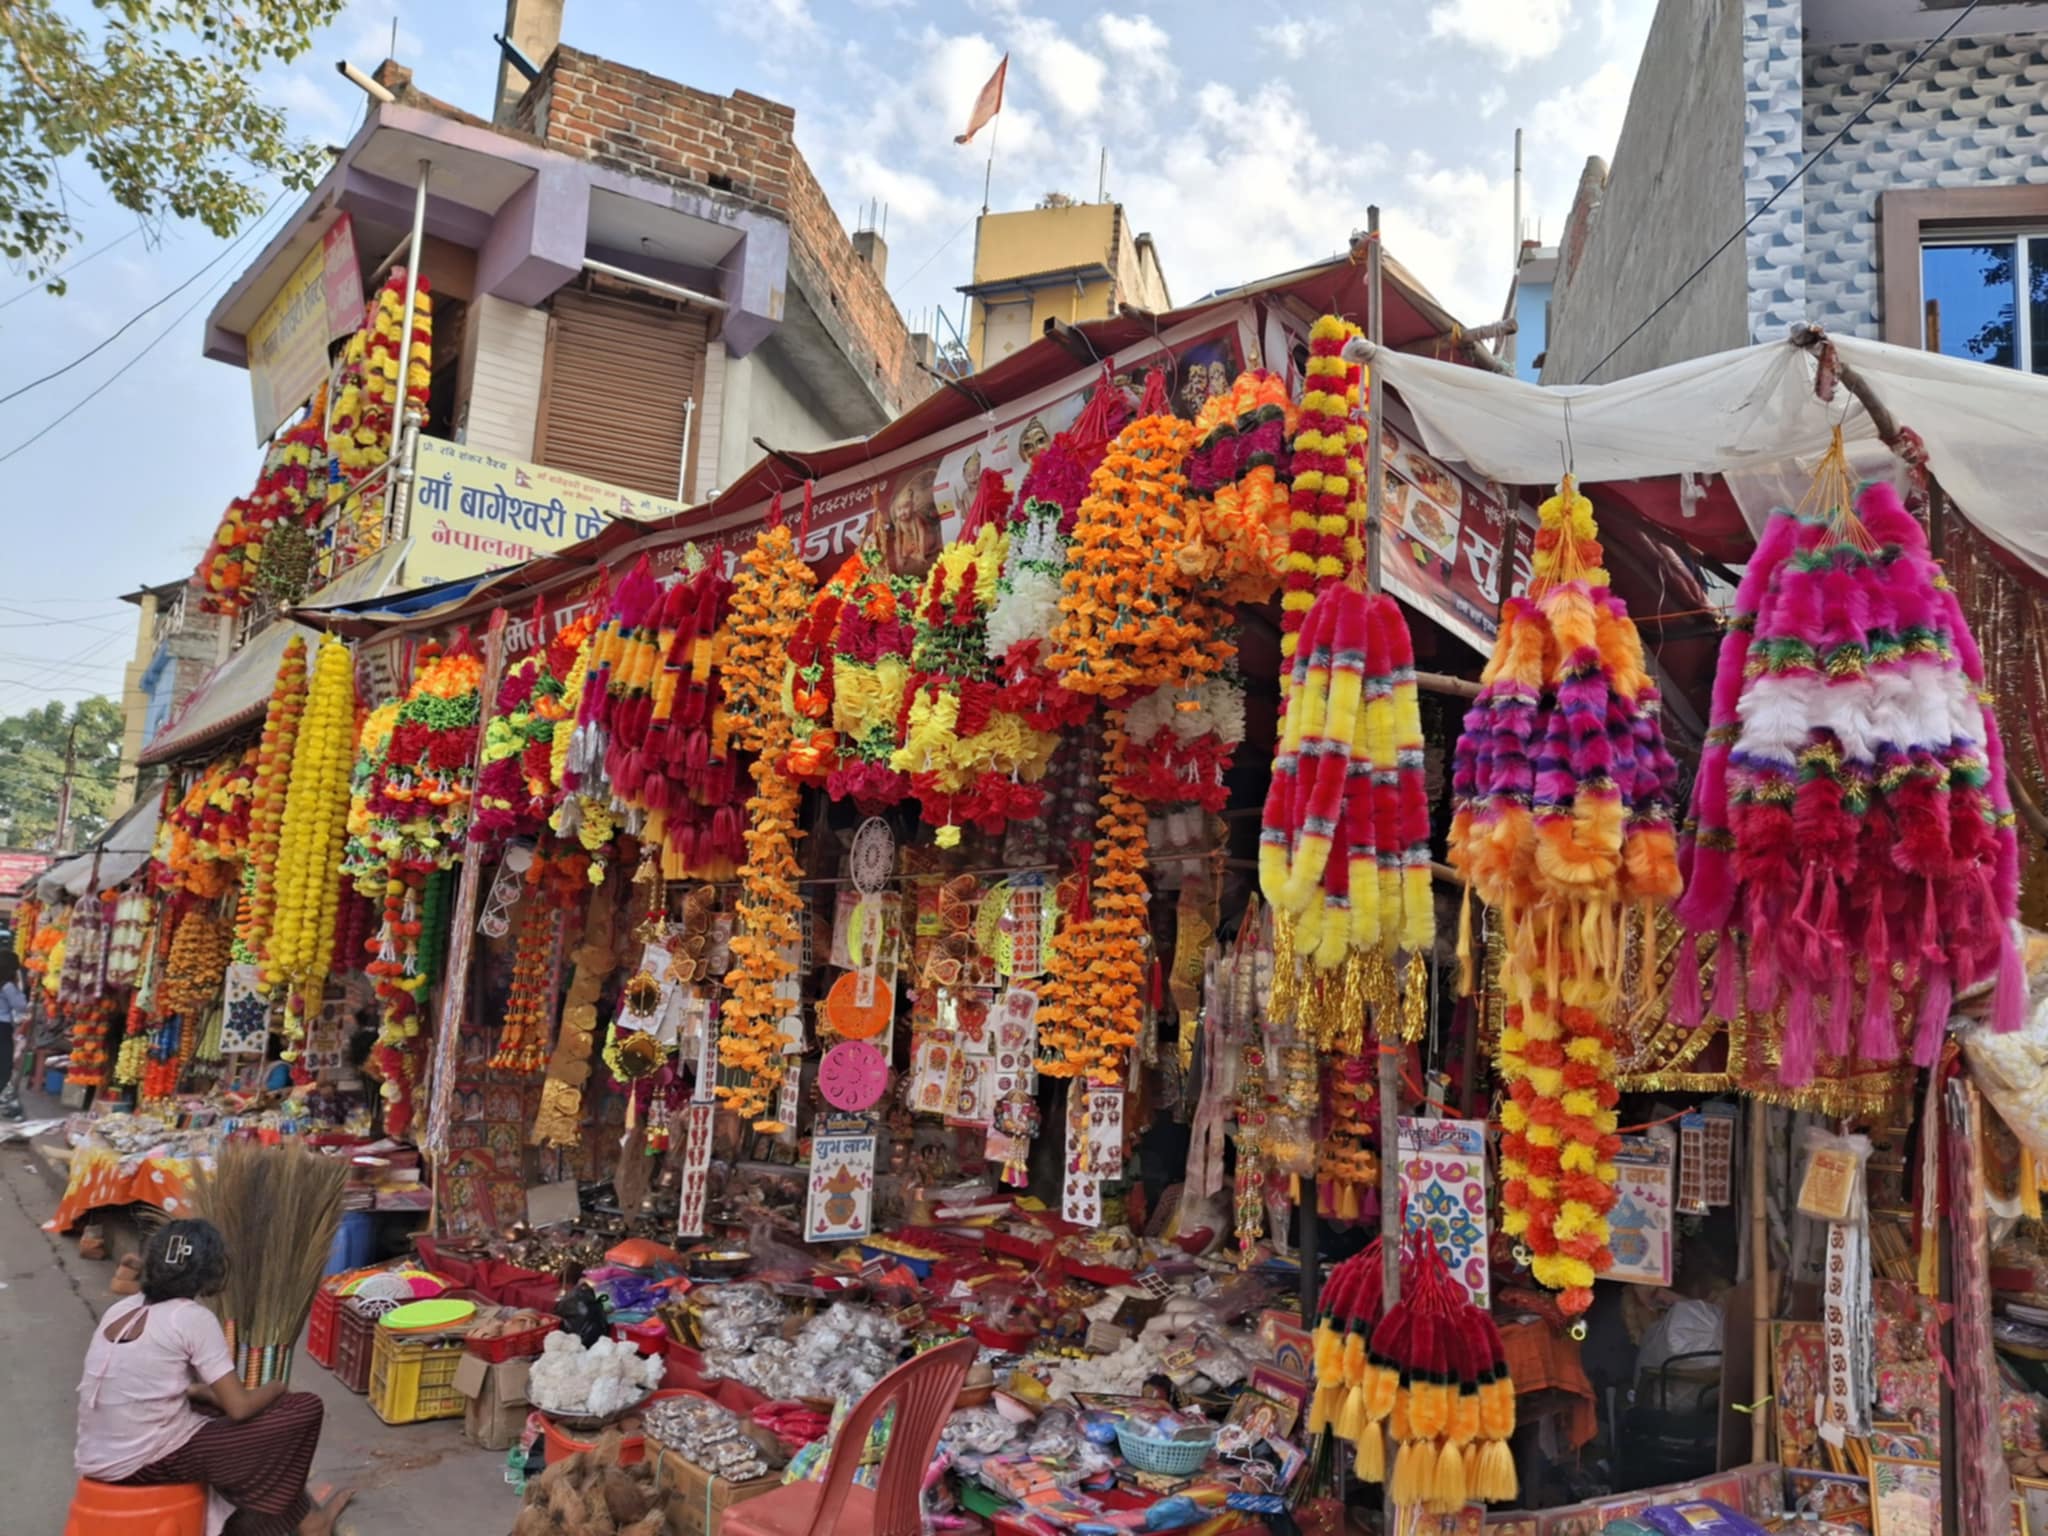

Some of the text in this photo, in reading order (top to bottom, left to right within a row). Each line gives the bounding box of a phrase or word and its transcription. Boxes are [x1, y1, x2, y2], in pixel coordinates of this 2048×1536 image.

[418, 472, 453, 512] माँ
[460, 483, 567, 538] बागेश्वरी
[816, 1138, 873, 1159] शुभ लाभ
